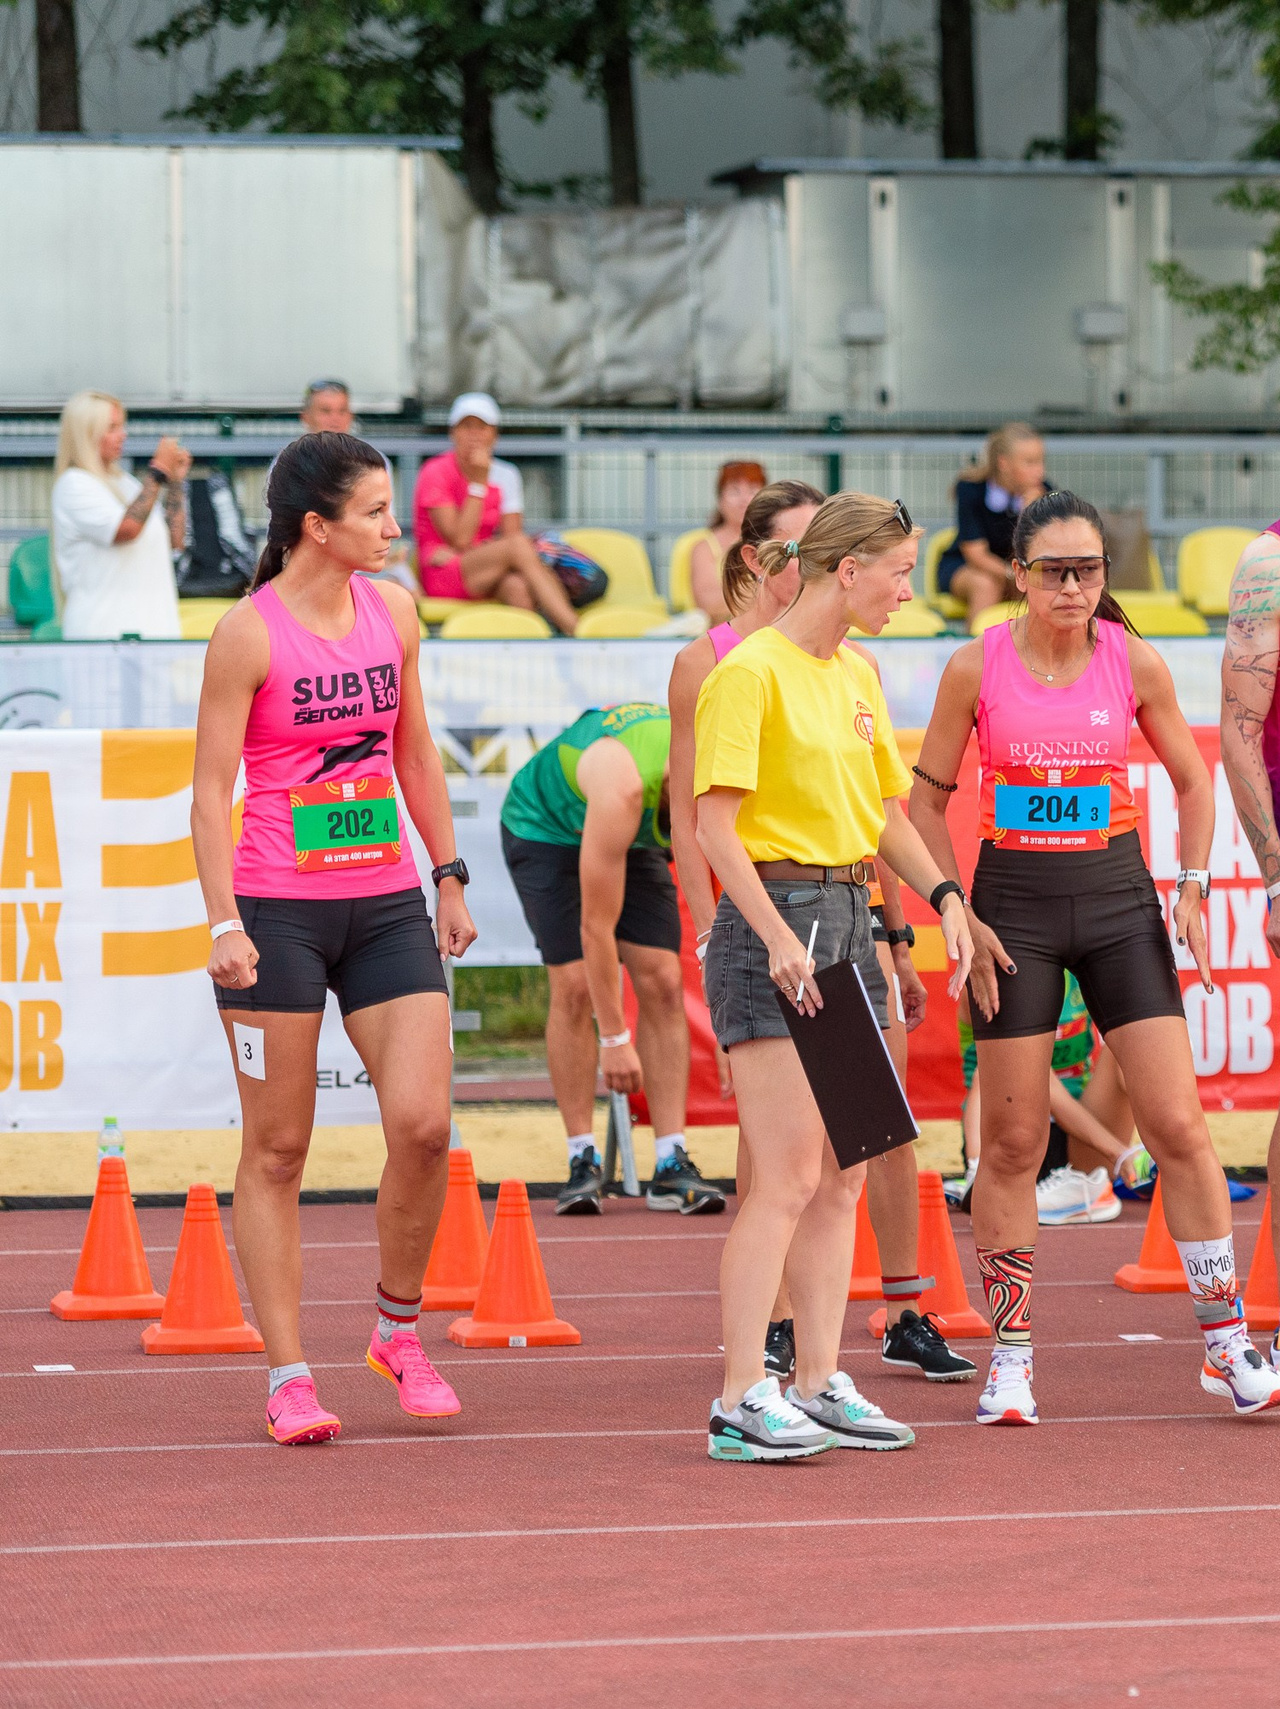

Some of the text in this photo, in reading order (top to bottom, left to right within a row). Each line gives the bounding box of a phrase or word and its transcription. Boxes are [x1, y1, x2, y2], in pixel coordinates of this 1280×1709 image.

[292, 672, 363, 705] SUB
[375, 687, 397, 709] 30
[1009, 740, 1110, 758] RUNNING
[1028, 795, 1099, 823] 204 3
[327, 808, 391, 840] 202 4
[1030, 836, 1047, 845] этап
[1047, 836, 1061, 845] 800
[1061, 837, 1087, 847] метров
[333, 854, 350, 863] этап
[350, 851, 362, 861] 400
[362, 850, 383, 860] метров
[244, 1042, 253, 1060] 3
